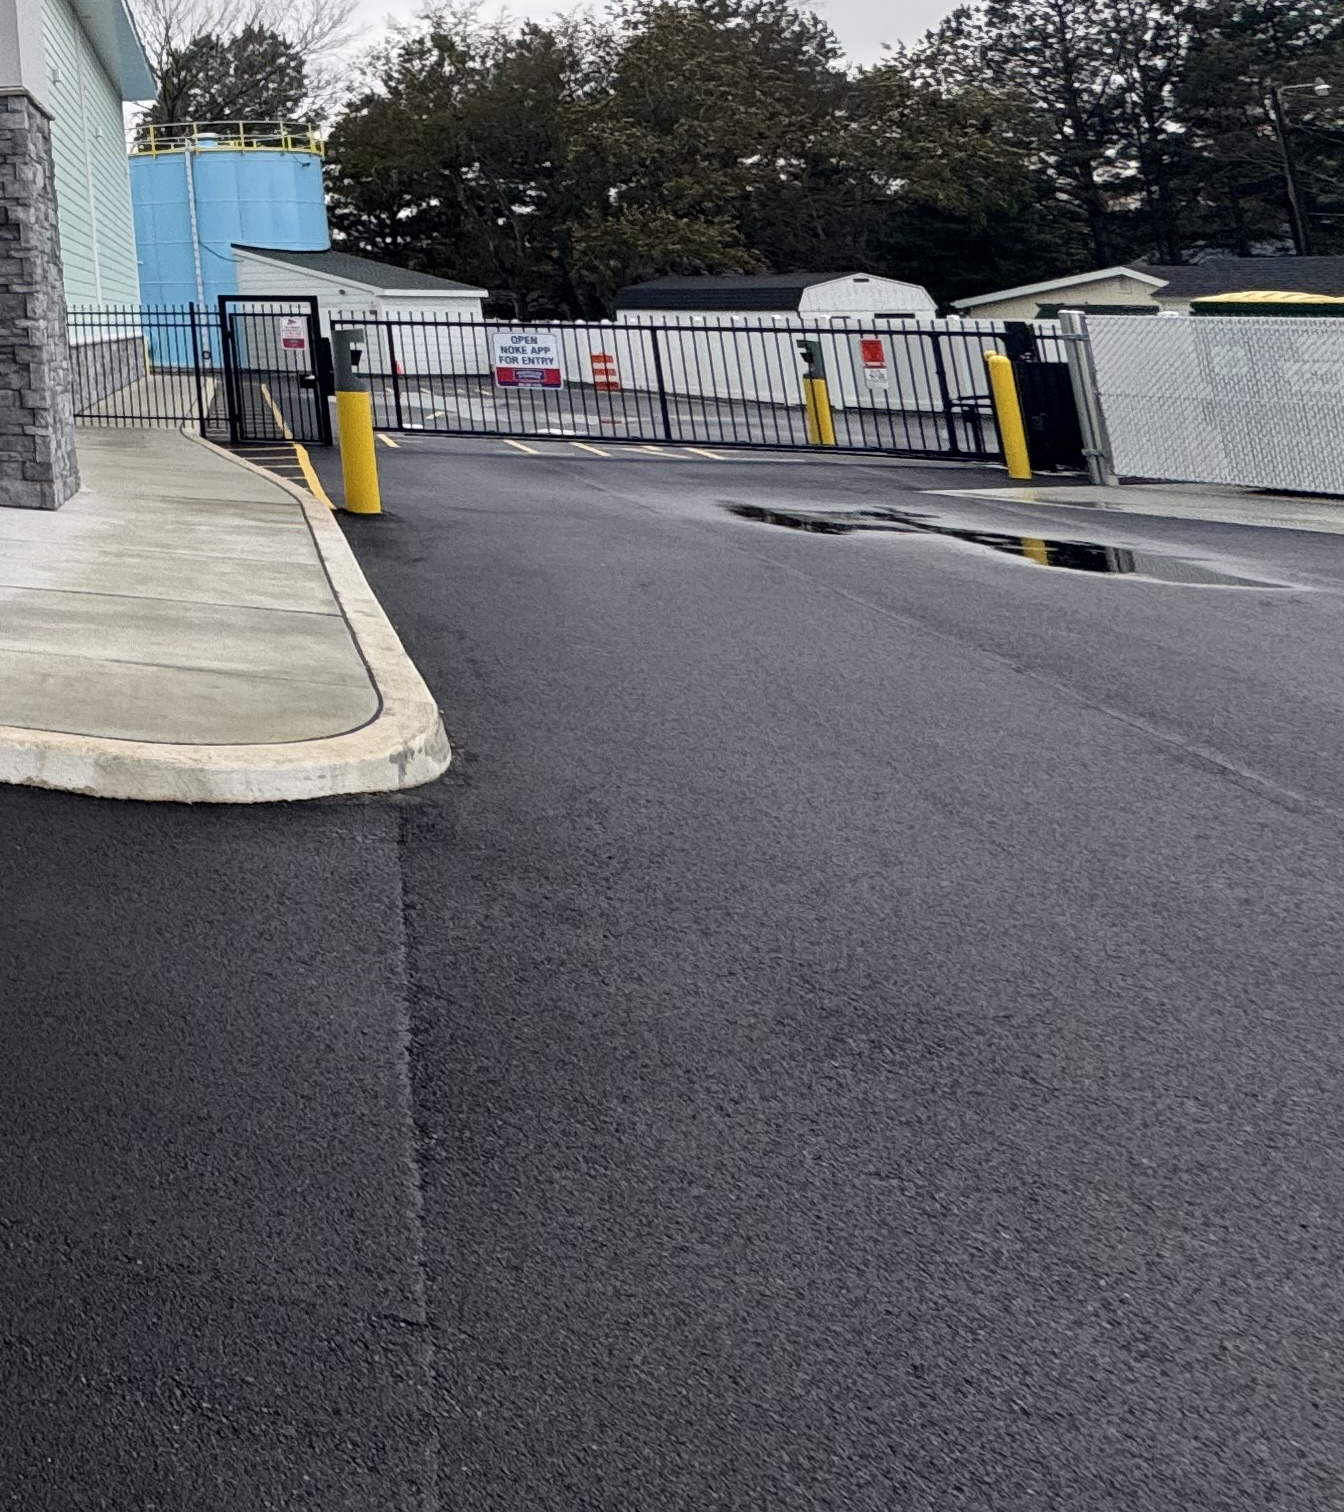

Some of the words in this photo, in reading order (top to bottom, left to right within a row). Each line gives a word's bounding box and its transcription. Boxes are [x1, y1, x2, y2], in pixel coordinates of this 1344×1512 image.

[511, 335, 538, 345] OPEN
[531, 346, 551, 355] APP
[499, 355, 519, 365] FOR
[522, 356, 554, 365] ENTRY
